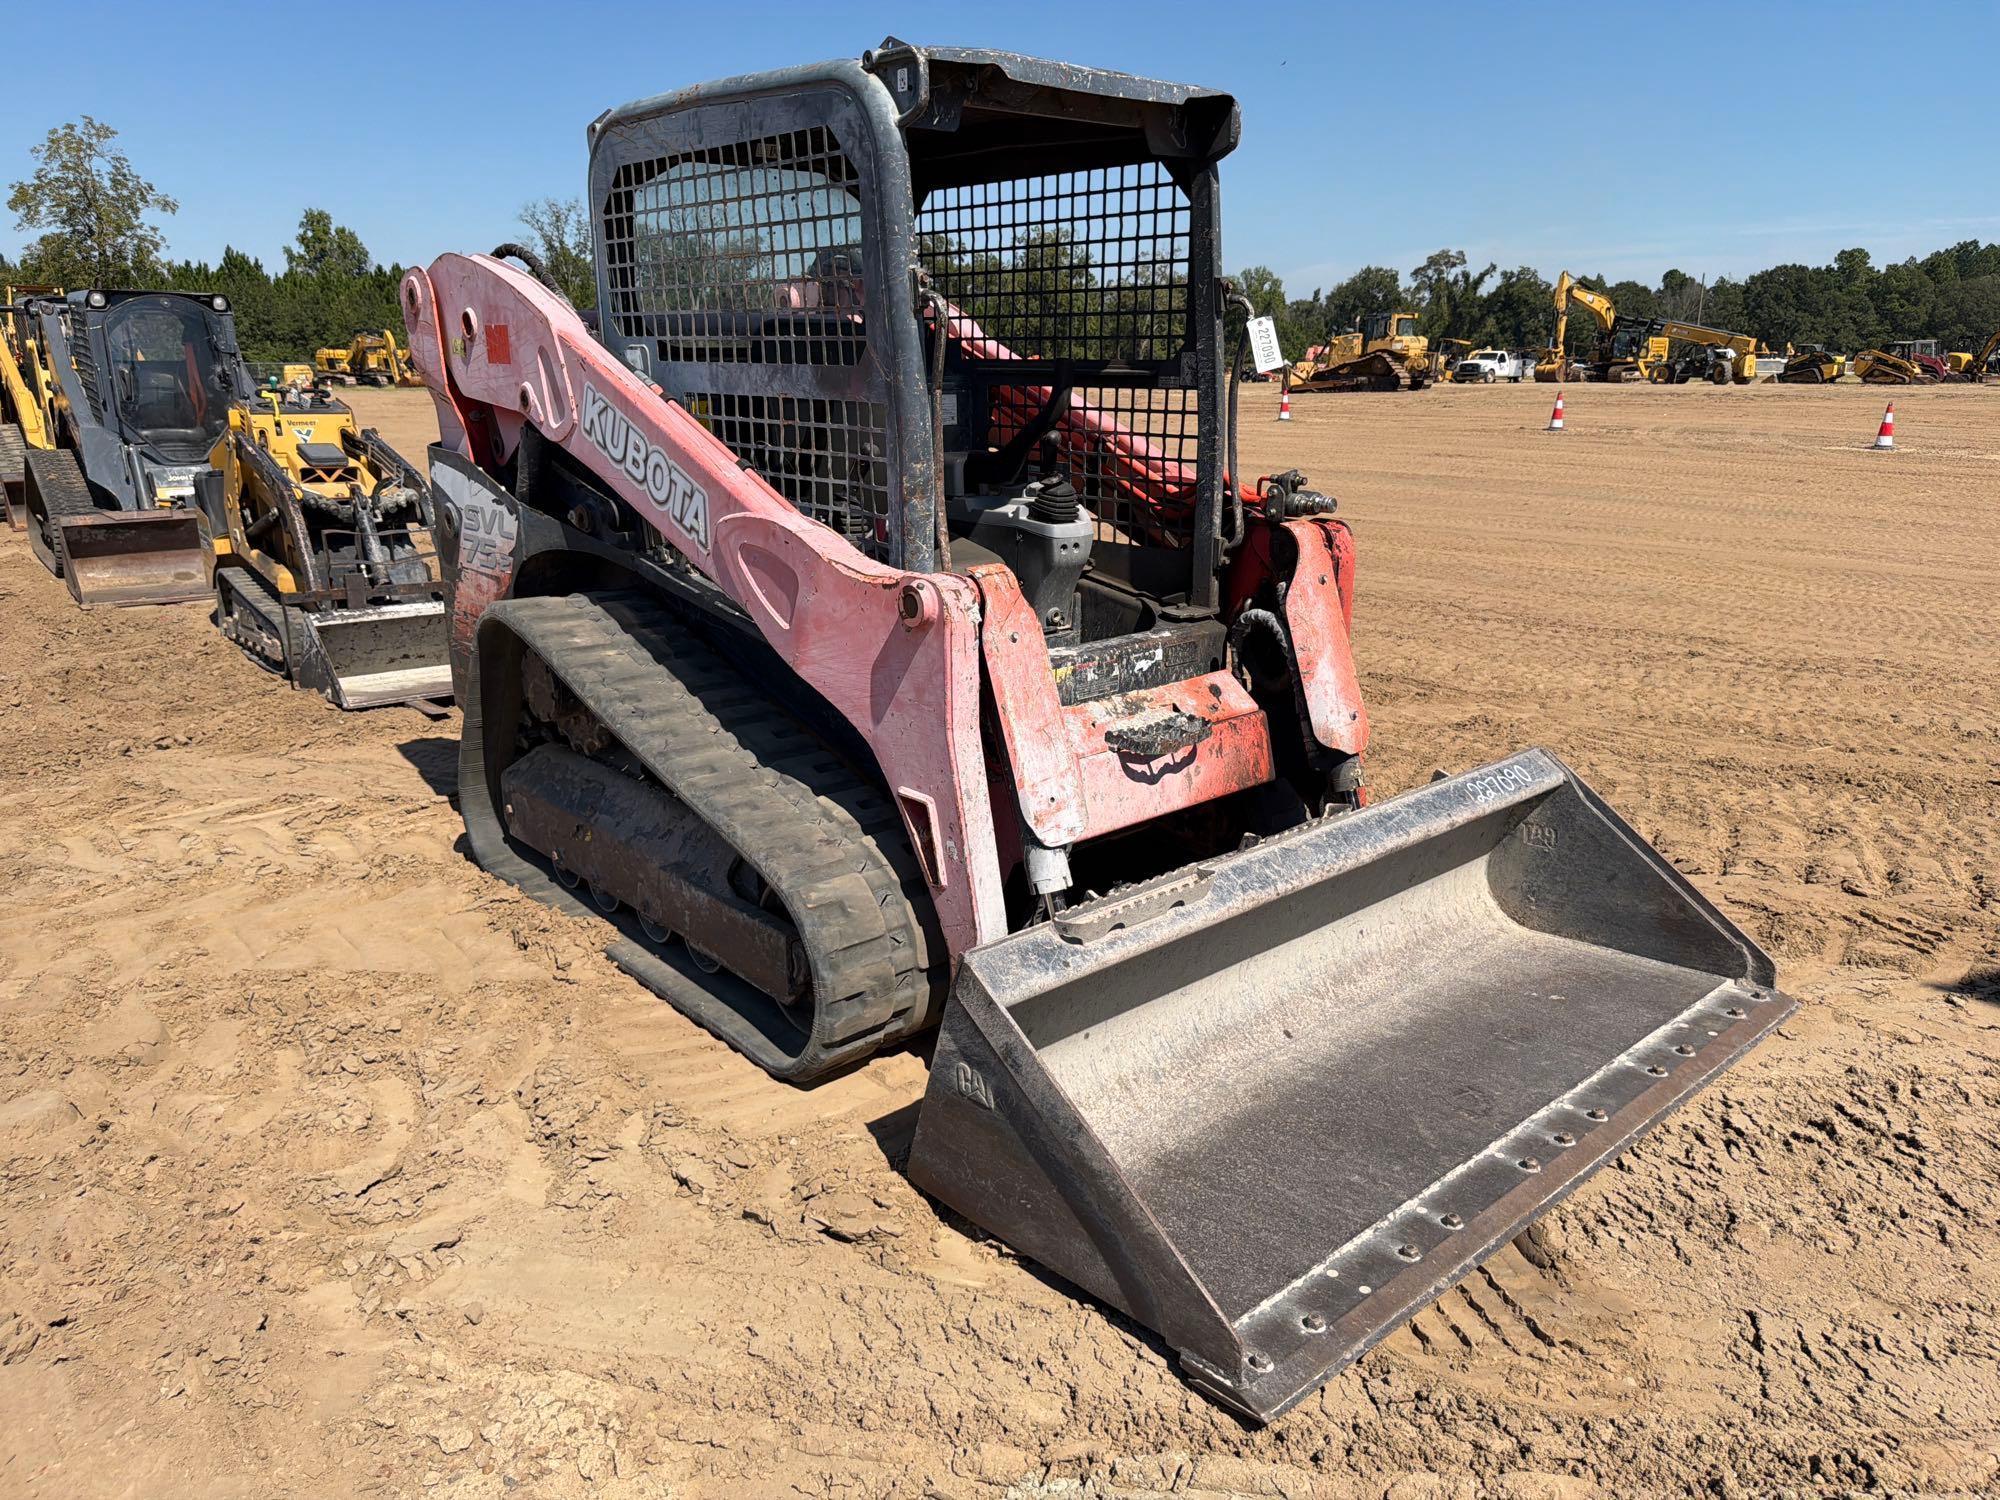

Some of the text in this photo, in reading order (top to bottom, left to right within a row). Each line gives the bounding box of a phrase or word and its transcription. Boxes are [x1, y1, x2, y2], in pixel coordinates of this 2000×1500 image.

[1258, 328, 1276, 364] 227090
[286, 419, 317, 427] Vermeer
[582, 384, 711, 551] KUBOTA
[463, 504, 515, 541] SVL
[1466, 765, 1532, 803] 227090
